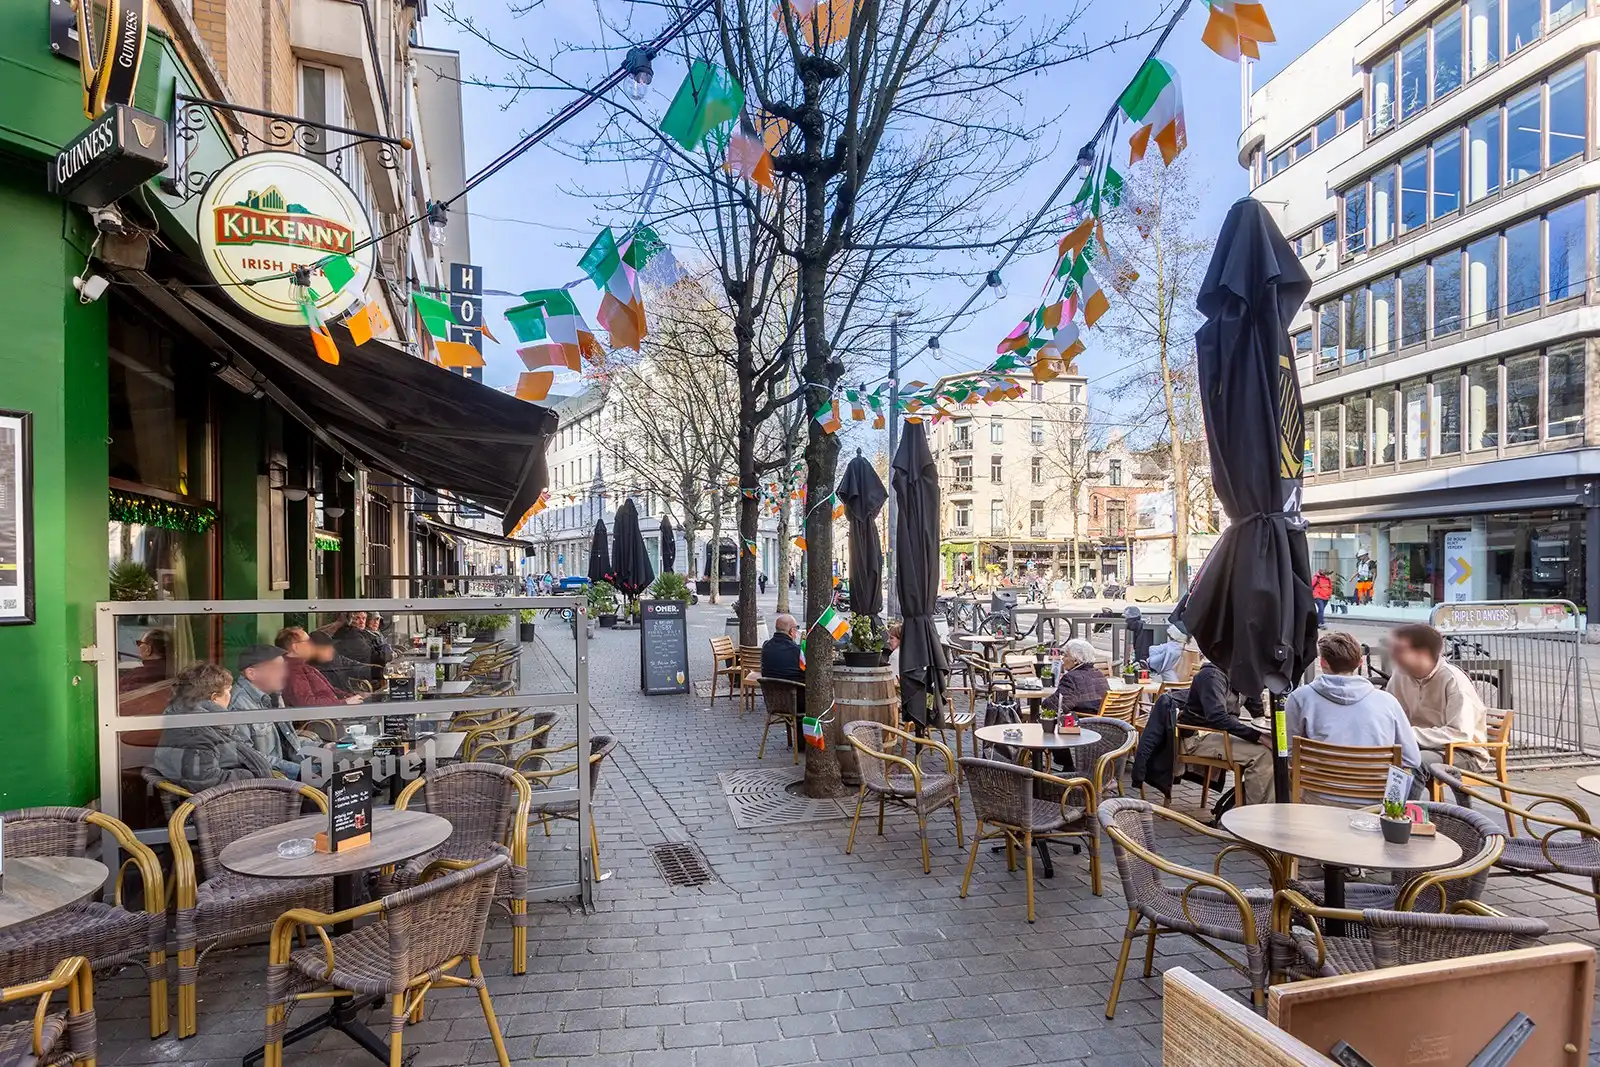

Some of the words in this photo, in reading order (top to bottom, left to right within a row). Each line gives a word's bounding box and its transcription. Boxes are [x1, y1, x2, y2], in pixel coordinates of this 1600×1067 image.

[118, 10, 139, 68] GUINNESS
[57, 119, 112, 184] GUINNESS
[223, 213, 348, 248] KILKENNY
[242, 258, 283, 271] IRISH
[1451, 609, 1475, 622] TRIPLE
[1476, 609, 1510, 621] D'ANVERS
[298, 738, 436, 788] Dvel
